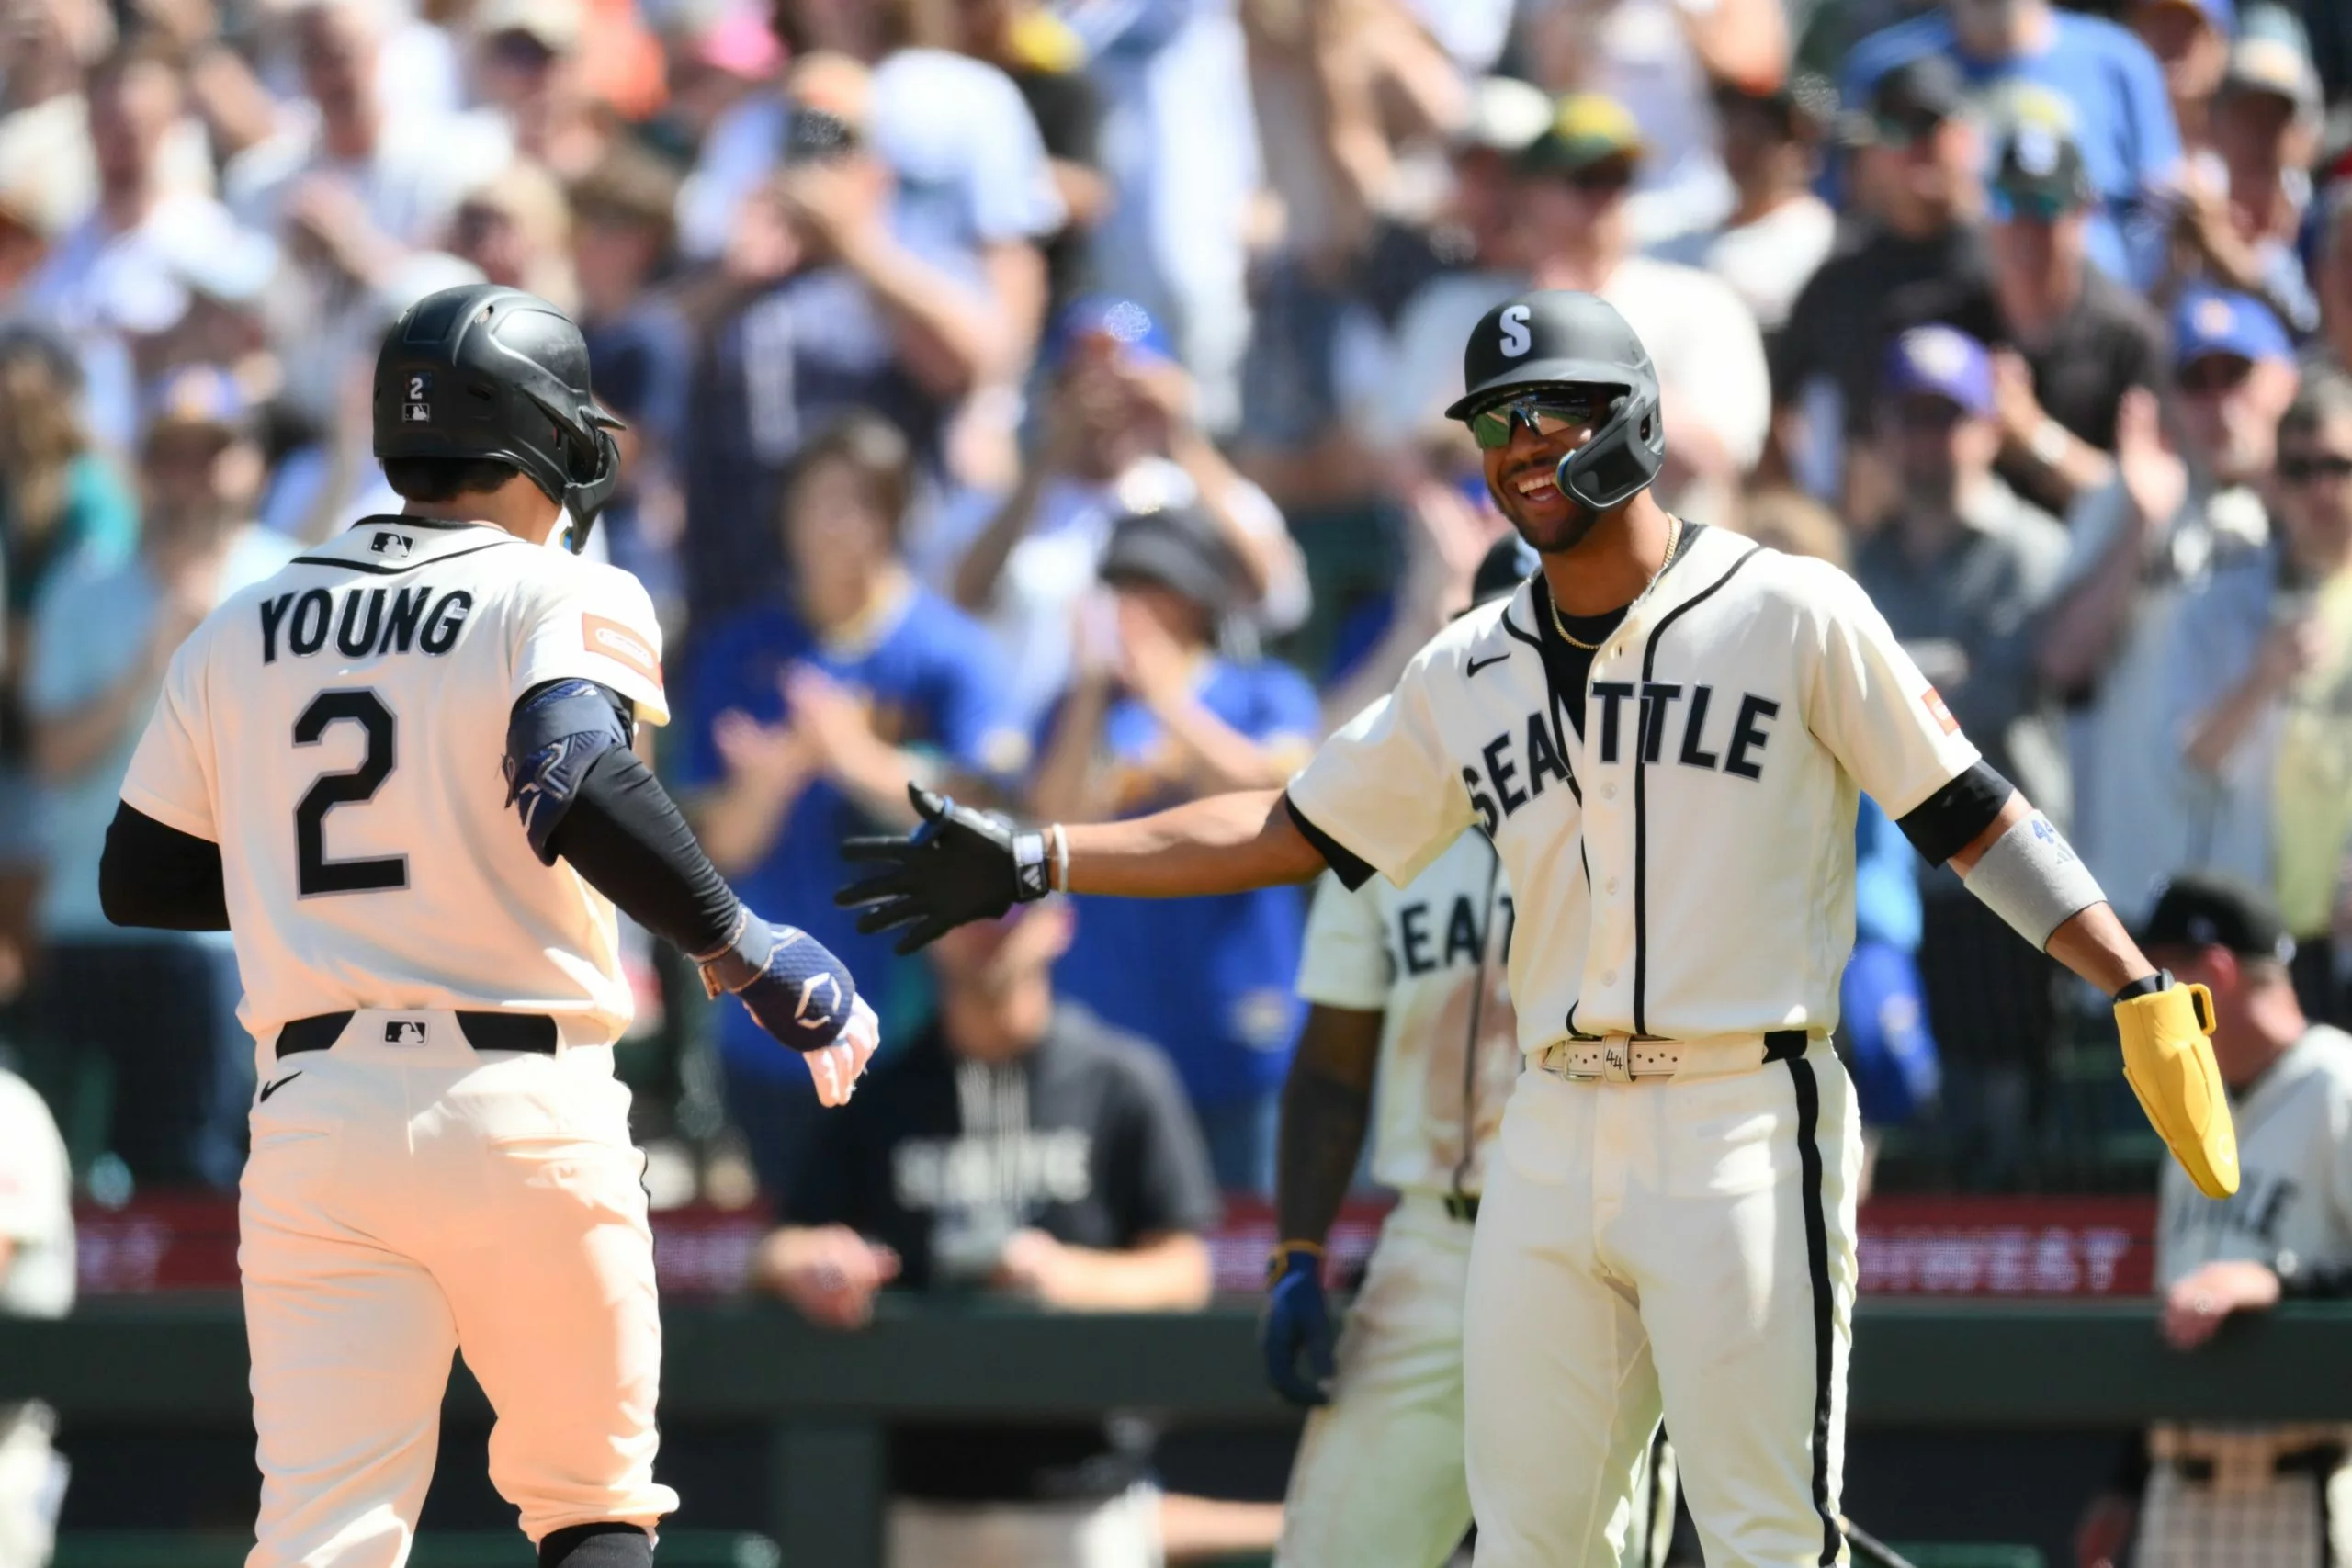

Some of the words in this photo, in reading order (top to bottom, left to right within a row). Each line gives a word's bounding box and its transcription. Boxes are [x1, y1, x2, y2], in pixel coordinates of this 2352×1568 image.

[1498, 304, 1532, 358] S
[410, 377, 424, 400] 2
[259, 586, 476, 666] YOUNG
[291, 685, 411, 901] 2
[1462, 681, 1781, 840] SEATTLE
[1605, 1048, 1623, 1070] 44
